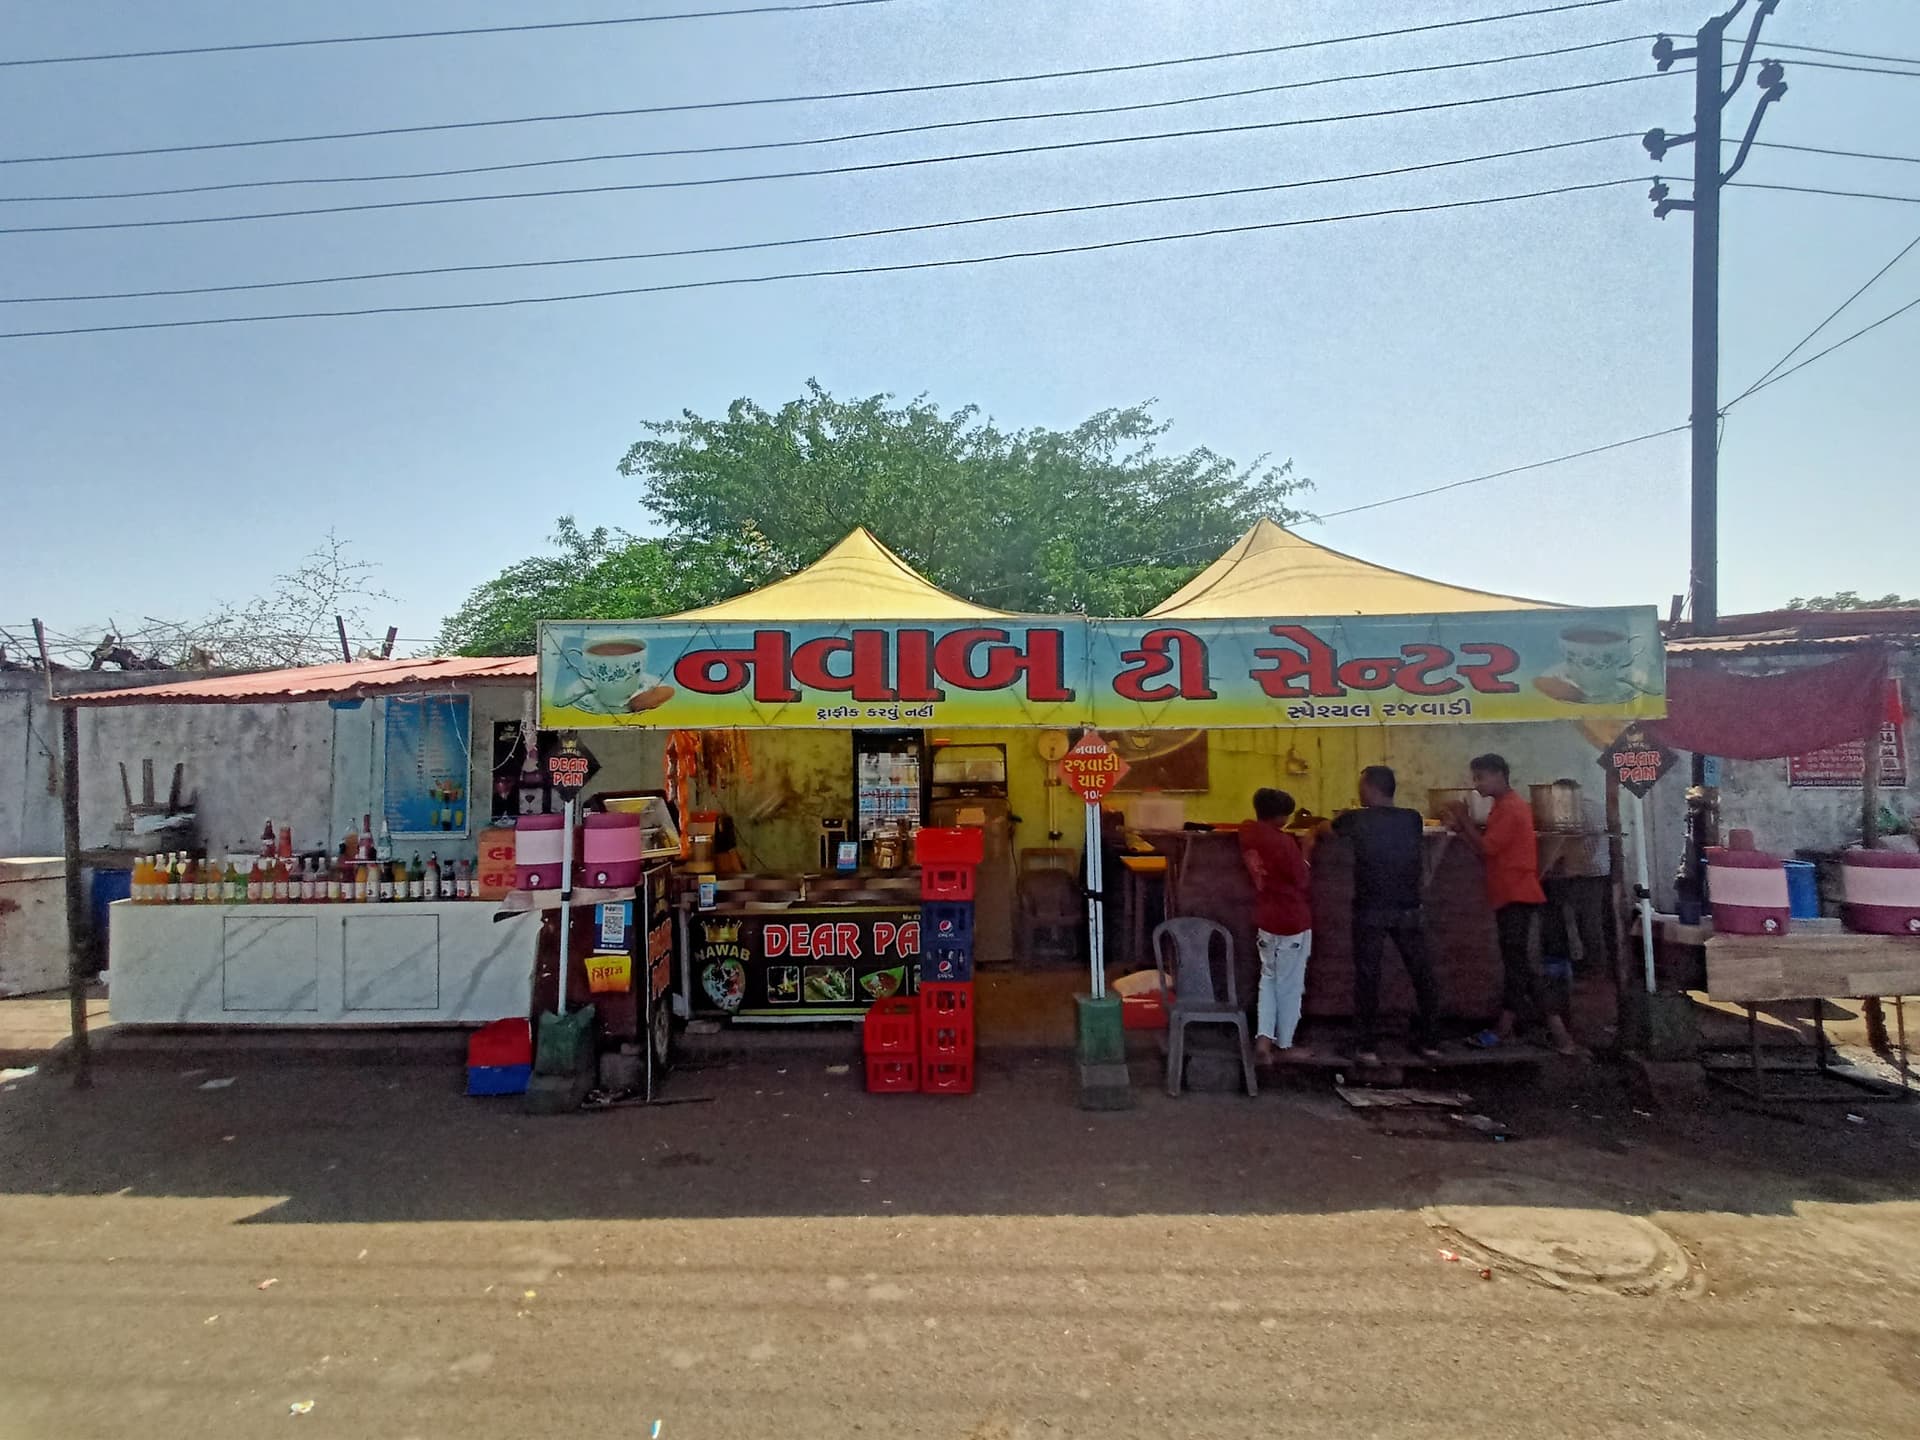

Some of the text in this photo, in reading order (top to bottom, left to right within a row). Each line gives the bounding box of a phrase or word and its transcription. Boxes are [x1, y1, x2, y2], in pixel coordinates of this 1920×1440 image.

[673, 625, 1521, 703] નવાબ ટી સેન્ટર
[1382, 697, 1472, 717] રજવાડી
[1075, 745, 1107, 755] નવાબ
[549, 757, 589, 774] DEAR
[1064, 752, 1120, 772] રજવાડી
[1613, 750, 1661, 768] DEAR
[553, 771, 584, 787] PAN
[1078, 774, 1107, 788] ચાહ
[1619, 766, 1657, 783] PAN
[1083, 790, 1103, 800] 10/-
[763, 921, 921, 960] DEAR PA
[694, 943, 751, 962] NAWAB
